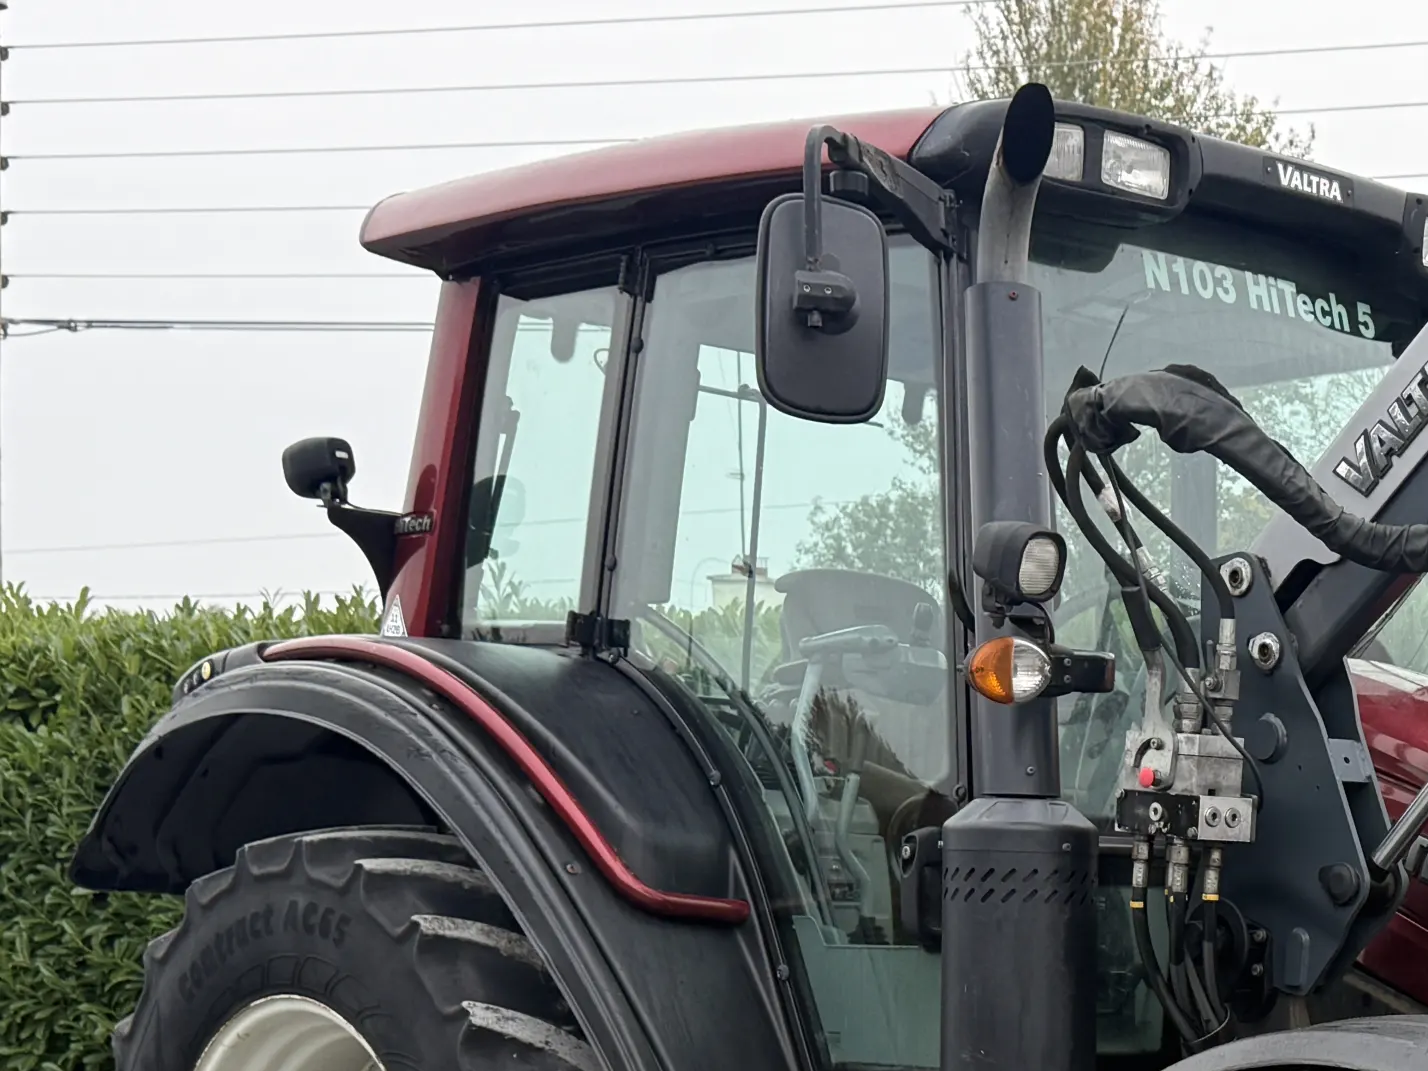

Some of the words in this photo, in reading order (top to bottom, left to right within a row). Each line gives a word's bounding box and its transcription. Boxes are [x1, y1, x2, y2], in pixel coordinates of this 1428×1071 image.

[1275, 161, 1343, 203] VALTRA
[1142, 250, 1237, 303] N103
[1245, 270, 1350, 332] HiTech
[1356, 301, 1376, 339] 5
